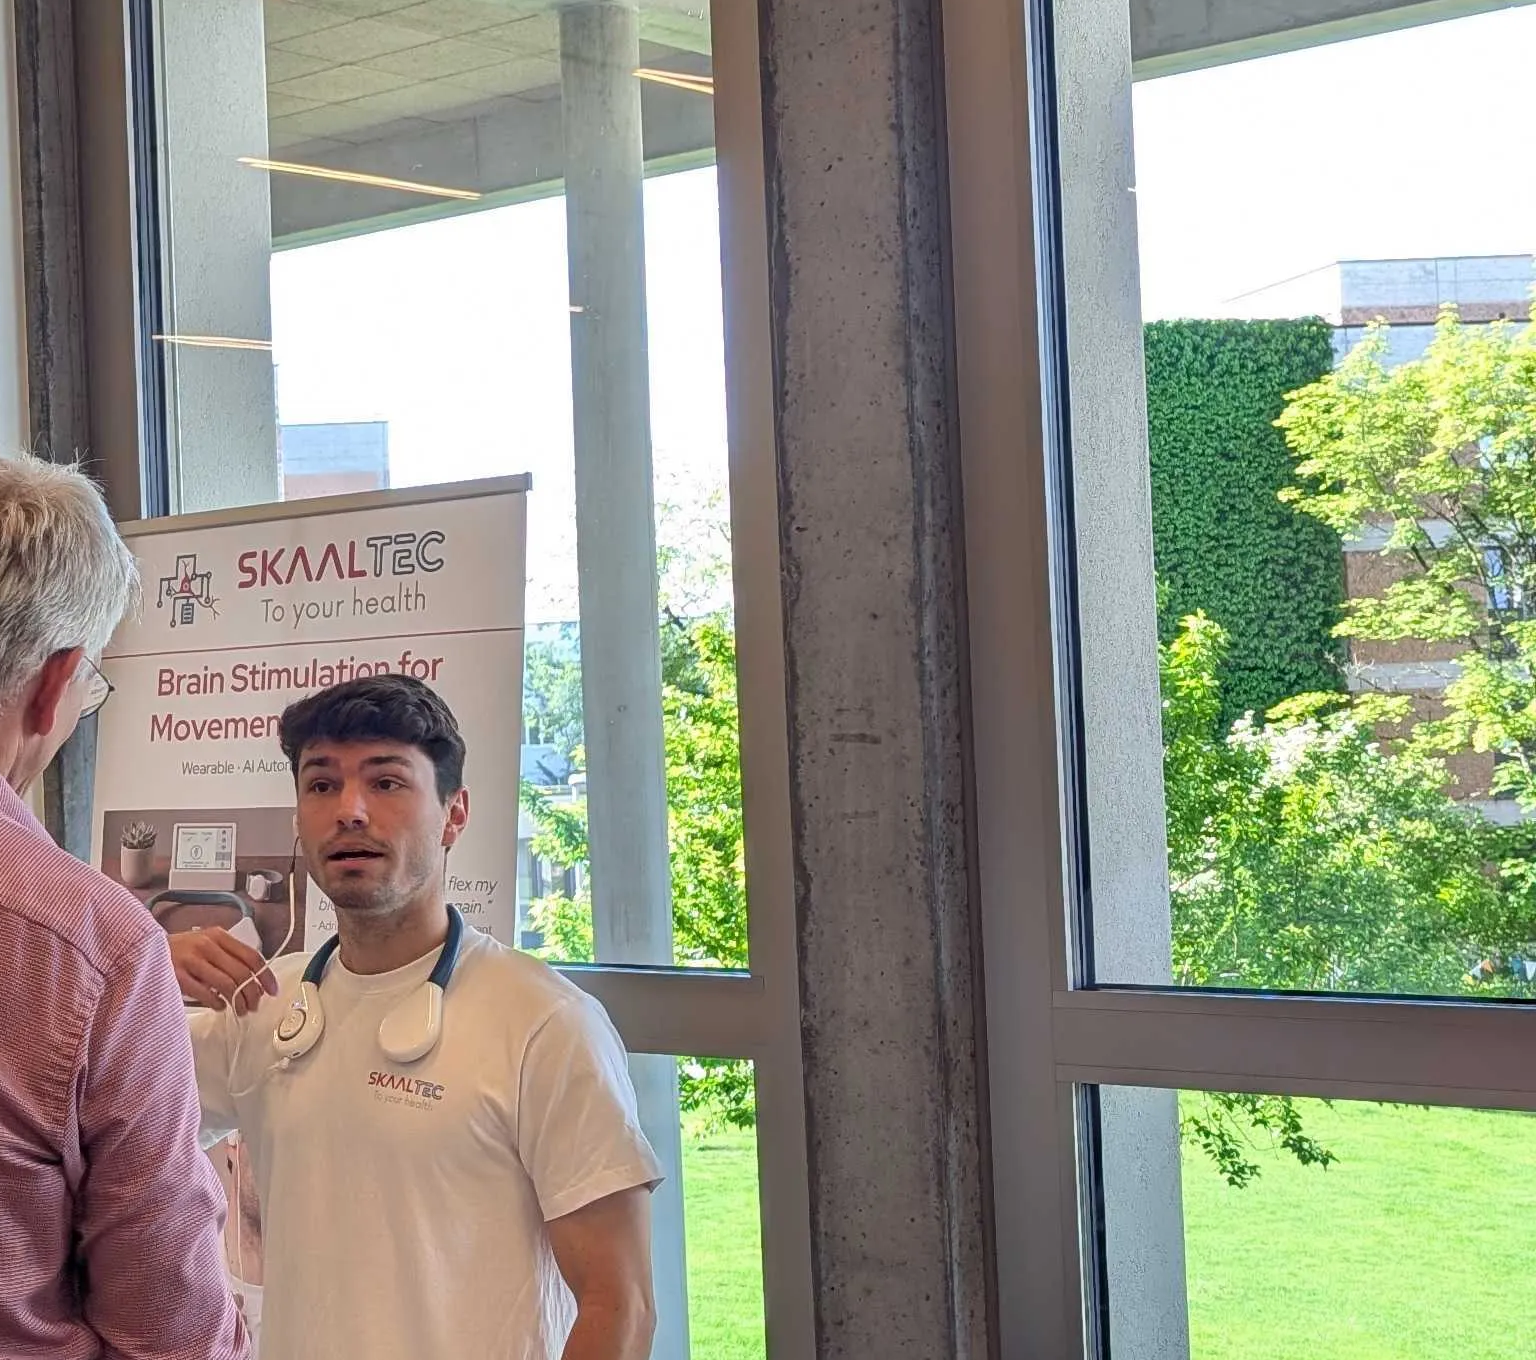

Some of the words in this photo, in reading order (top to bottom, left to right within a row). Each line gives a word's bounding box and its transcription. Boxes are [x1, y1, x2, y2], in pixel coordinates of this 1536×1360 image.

[237, 531, 446, 588] SKAALTEC
[261, 598, 285, 623] To
[292, 599, 345, 630] your
[352, 581, 427, 616] health
[157, 666, 225, 696] Brain
[231, 656, 390, 692] Stimulation
[398, 650, 444, 681] for
[150, 713, 281, 742] Movemen
[182, 760, 234, 775] Wearable
[449, 875, 472, 891] flex
[474, 879, 498, 896] my
[368, 1071, 445, 1101] SKAALTEC
